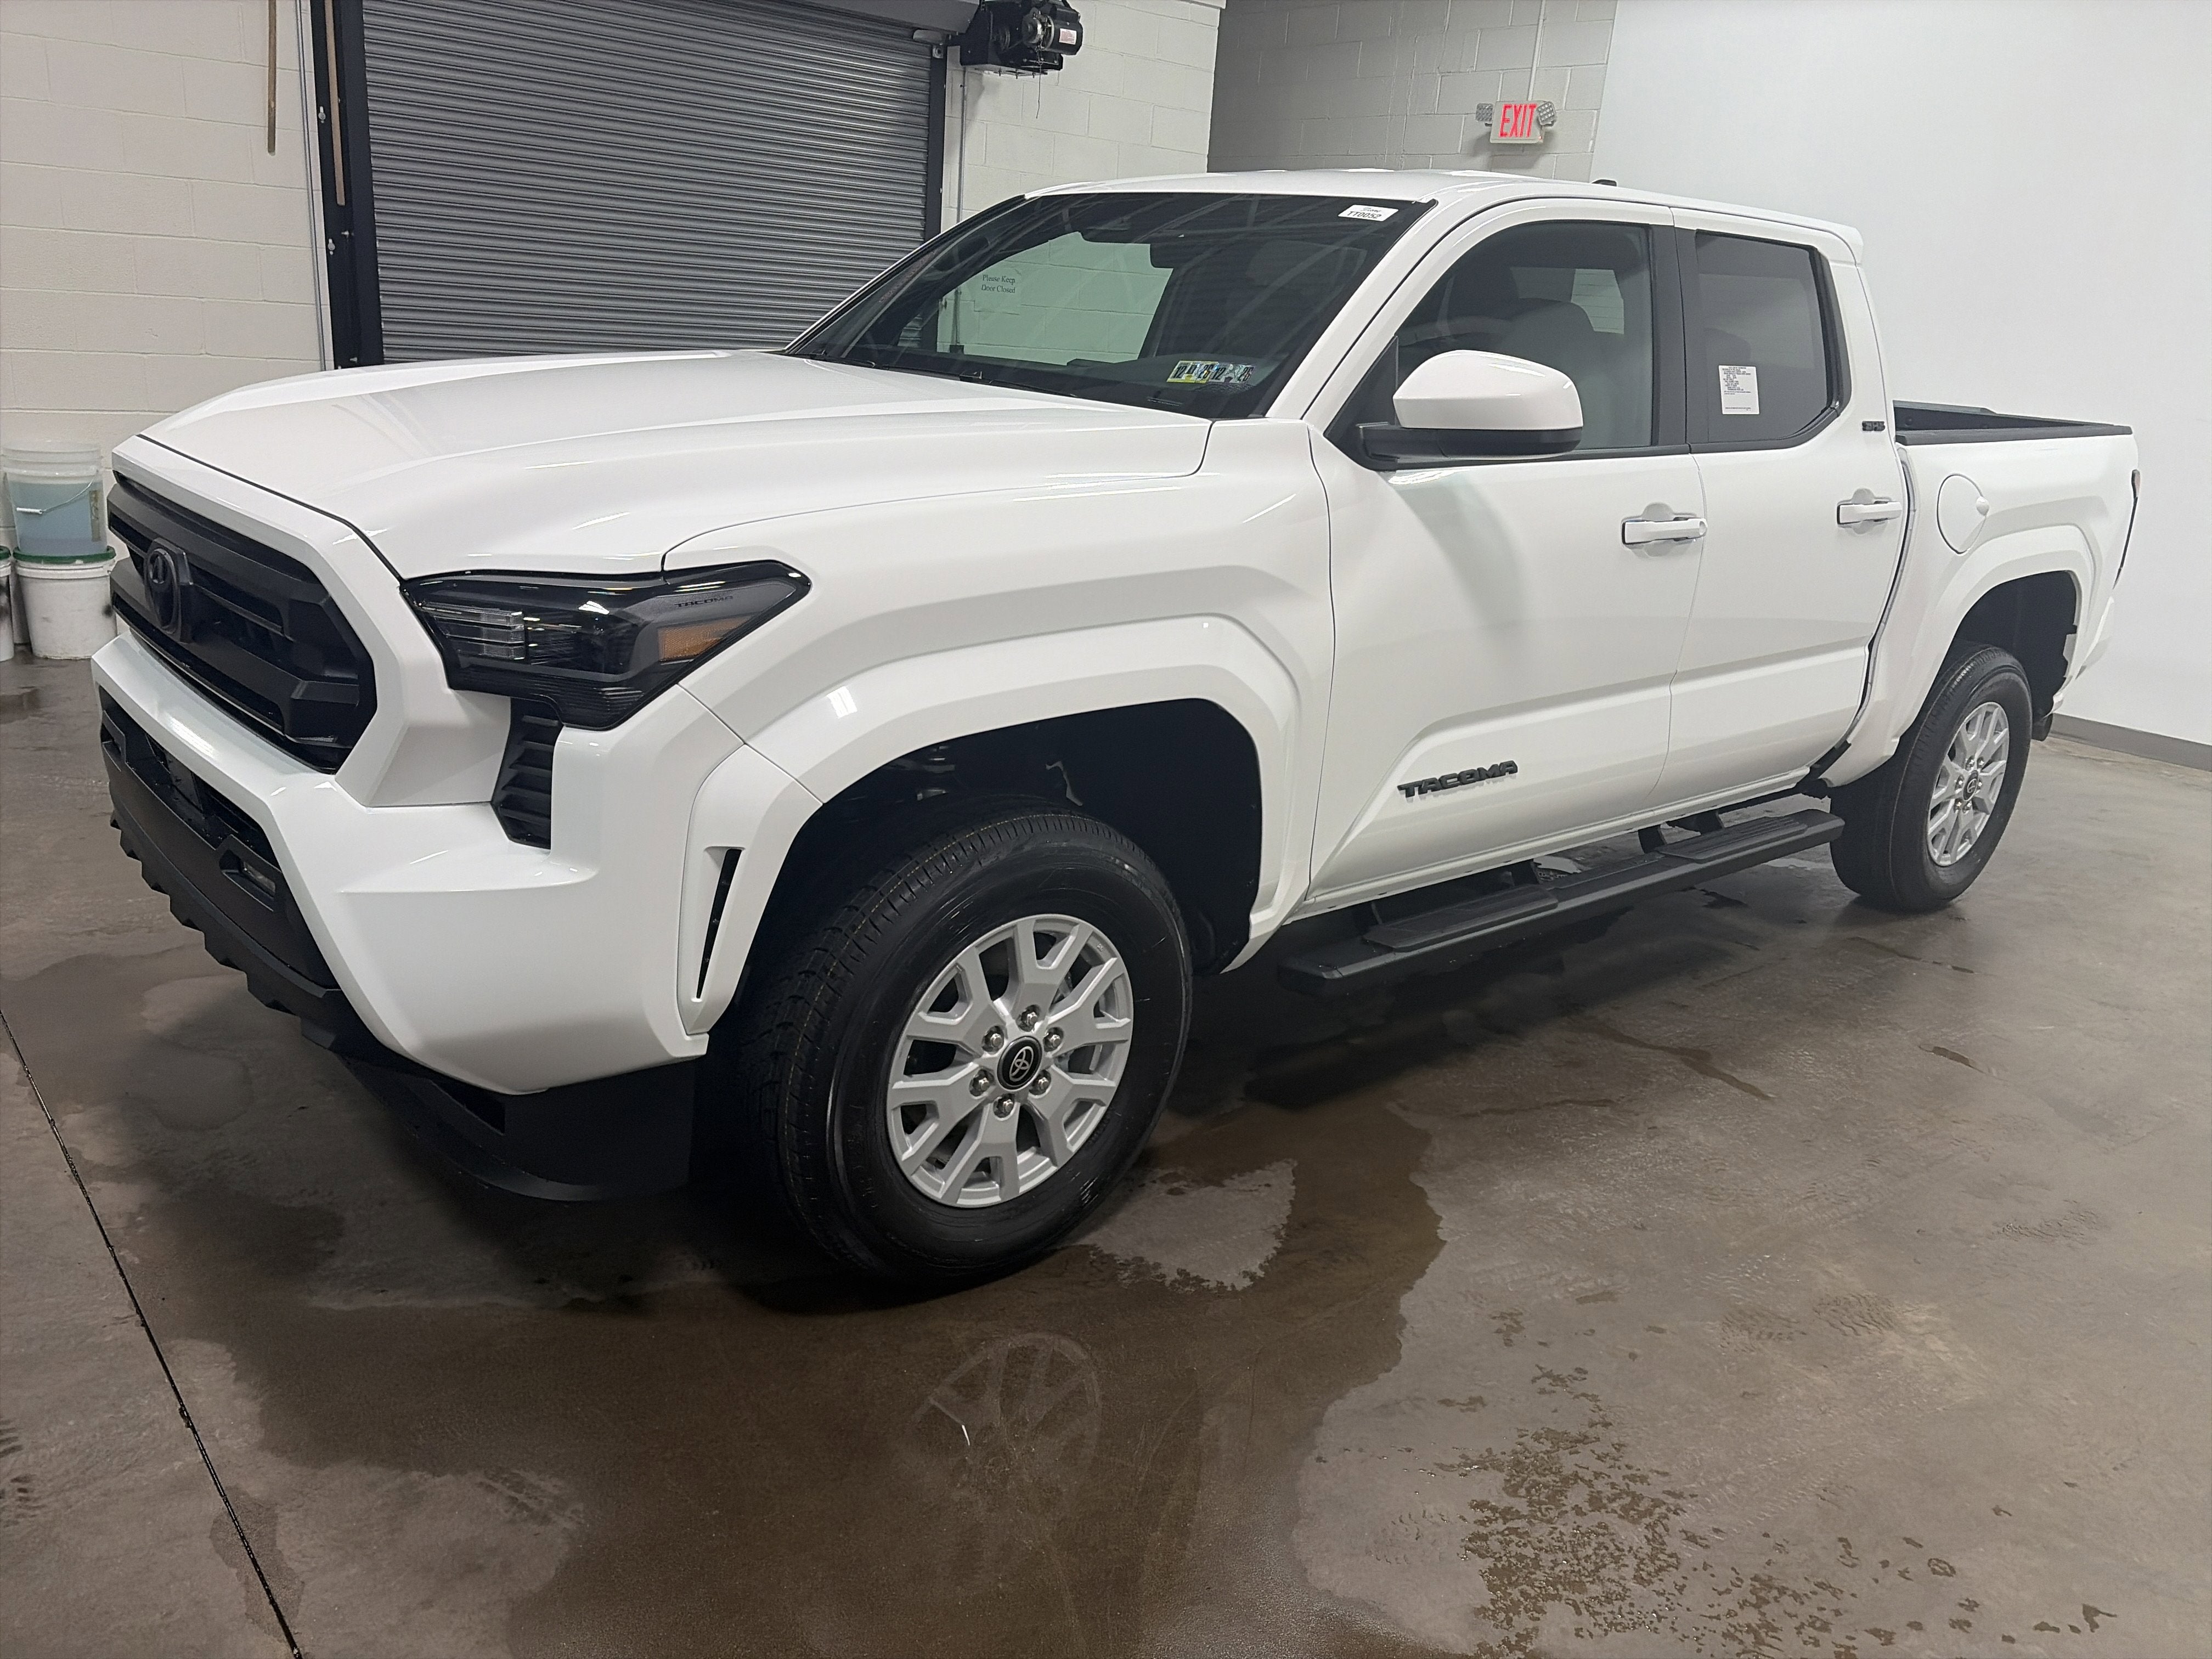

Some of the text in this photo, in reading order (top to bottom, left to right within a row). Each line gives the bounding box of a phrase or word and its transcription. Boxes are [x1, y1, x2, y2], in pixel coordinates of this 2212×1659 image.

[1499, 104, 1537, 138] EXIT
[1347, 211, 1382, 219] TT0052
[1001, 275, 1015, 285] Keep
[996, 285, 1015, 294] Closed
[1173, 365, 1187, 379] 12
[1212, 367, 1227, 380] 12
[674, 595, 733, 607] TACOMA
[1397, 760, 1519, 798] TACOMA
